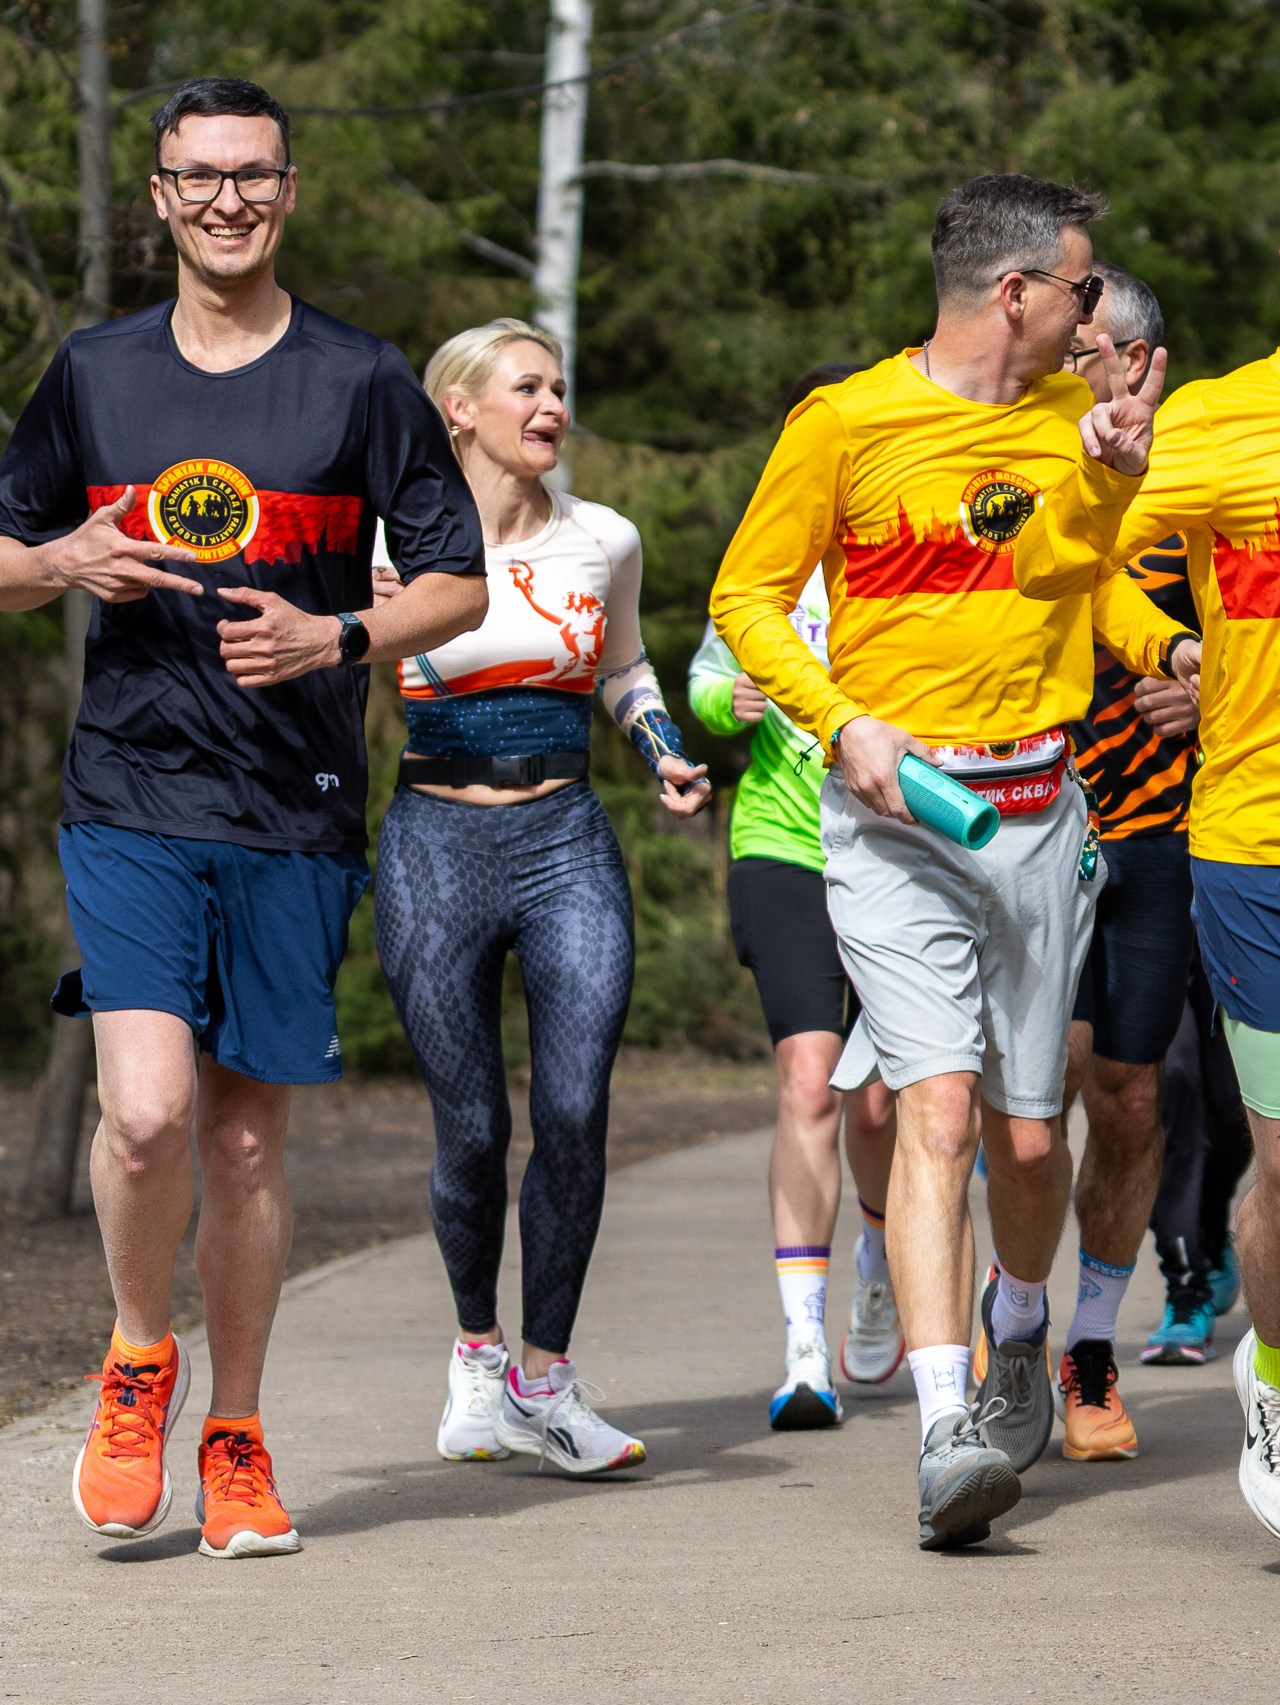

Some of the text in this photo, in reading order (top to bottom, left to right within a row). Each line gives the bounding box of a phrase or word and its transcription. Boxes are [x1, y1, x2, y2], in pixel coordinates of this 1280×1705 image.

[157, 463, 251, 496] SPARTAK MOSCOW
[963, 471, 1038, 502] SPARTAK MOSCOW
[169, 516, 197, 543] SQUAD
